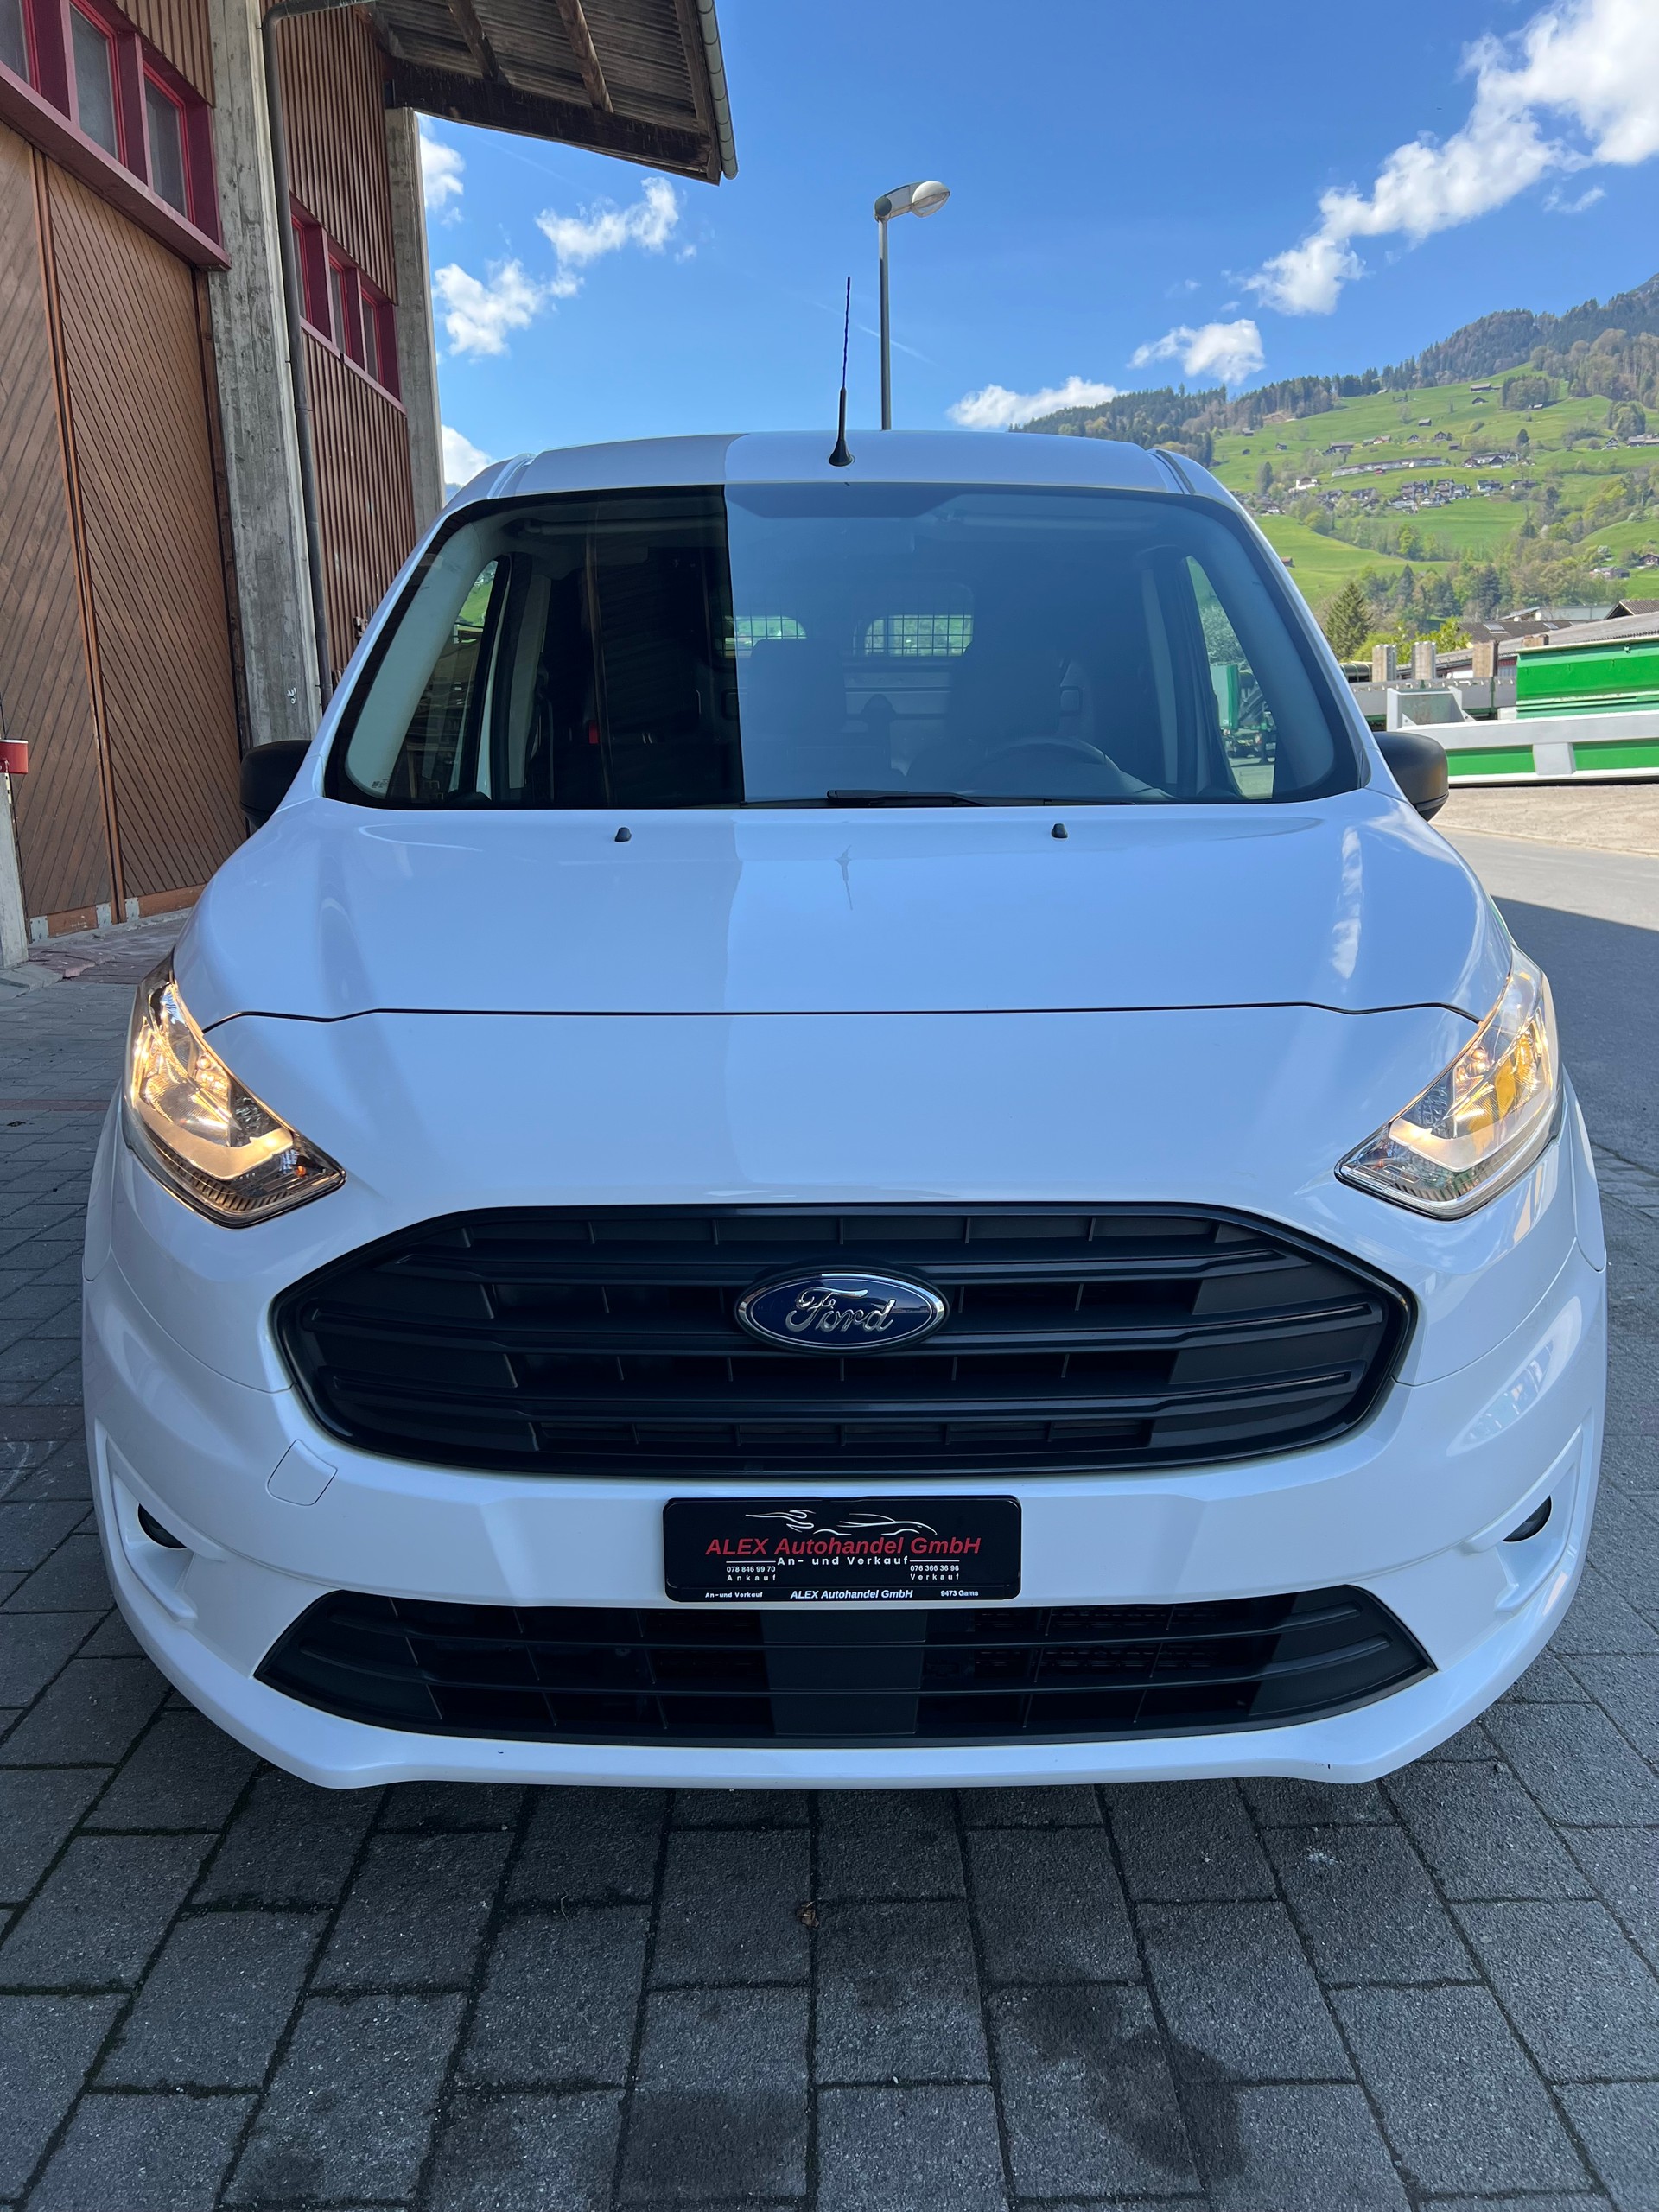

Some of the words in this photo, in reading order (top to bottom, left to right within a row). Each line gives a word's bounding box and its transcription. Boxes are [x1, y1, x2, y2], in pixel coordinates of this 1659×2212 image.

[785, 1287, 896, 1332] Ford
[705, 1538, 769, 1554] ALEX
[774, 1537, 904, 1554] Autohandel
[910, 1537, 981, 1554] GmbH
[847, 1556, 908, 1565] Verkauf
